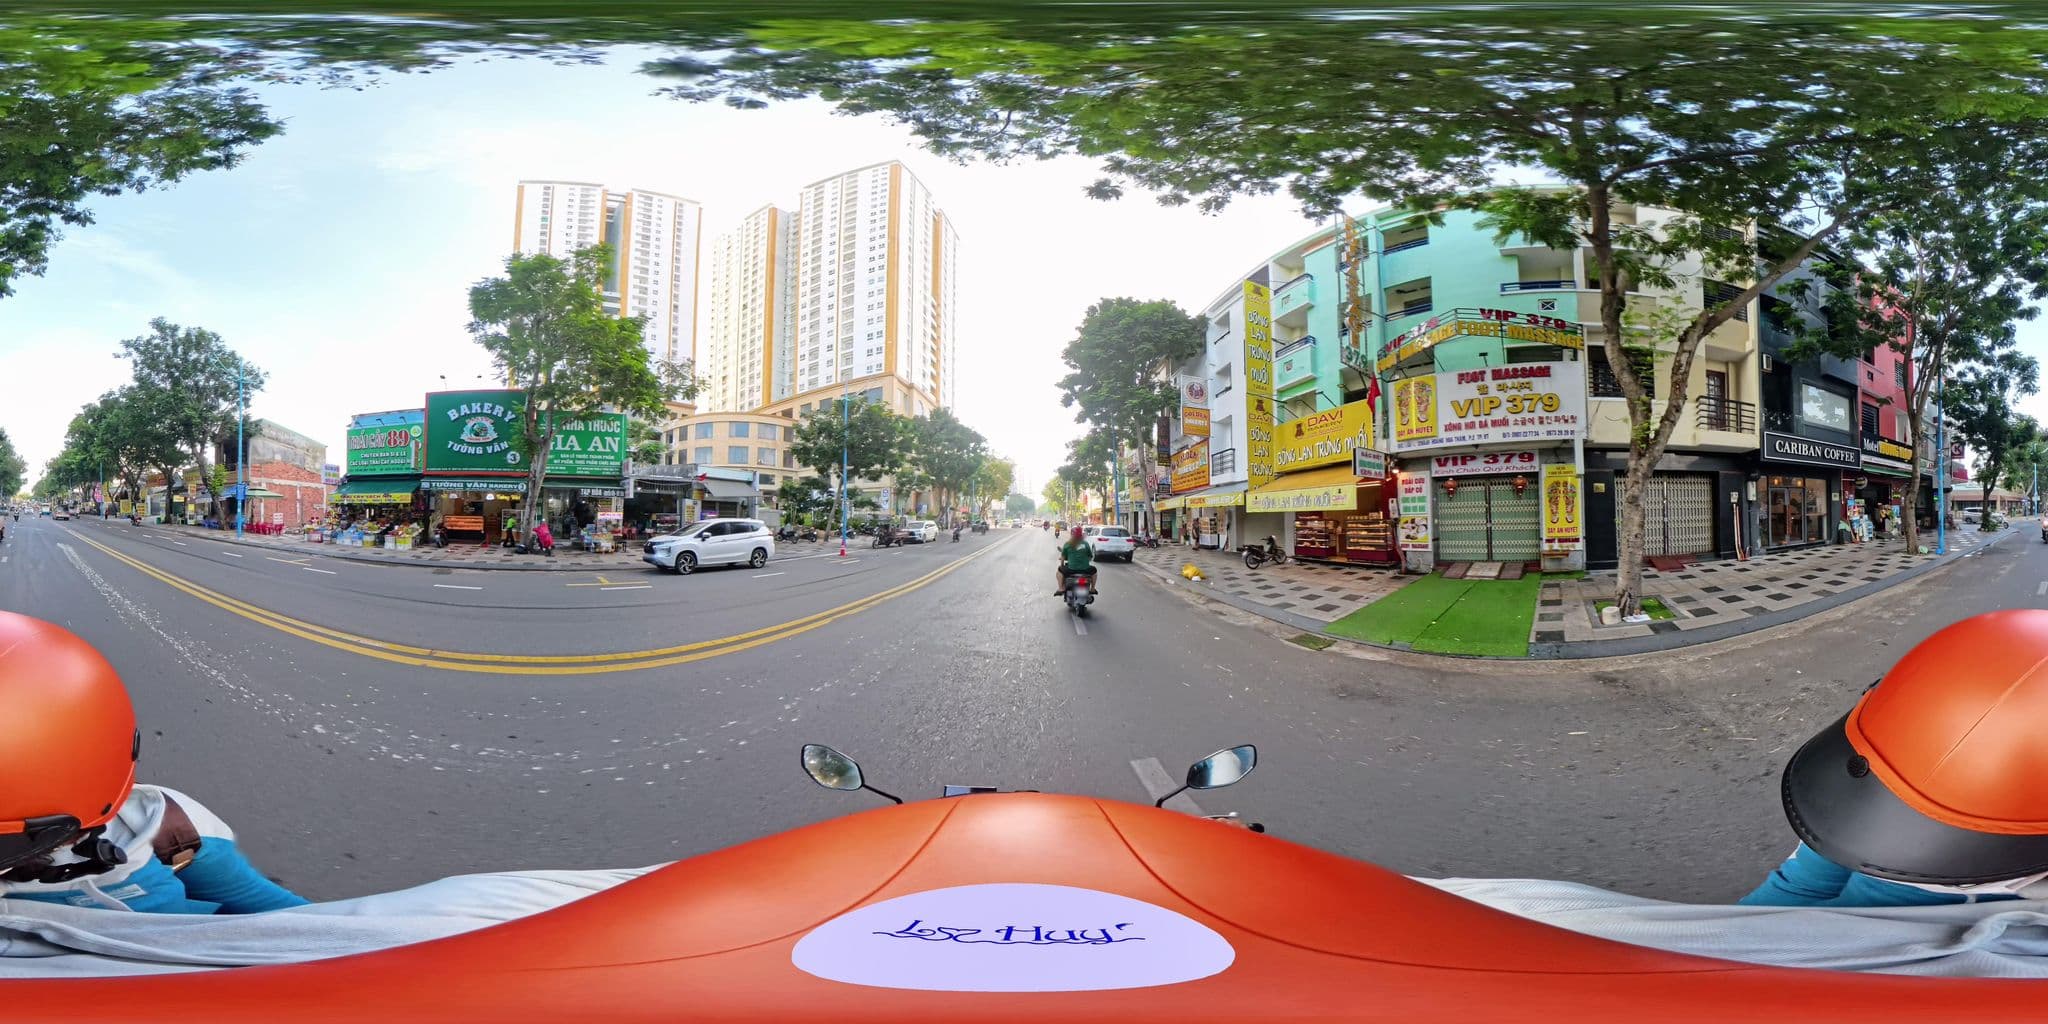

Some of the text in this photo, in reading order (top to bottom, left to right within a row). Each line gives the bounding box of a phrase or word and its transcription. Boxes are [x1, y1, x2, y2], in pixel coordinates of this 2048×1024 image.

[1479, 307, 1518, 322] VIP
[1251, 327, 1268, 343] LAN
[1384, 334, 1406, 354] VIP
[1456, 319, 1585, 351] FOOT MASSAGE
[1457, 365, 1552, 385] FOOT MASSAGE
[447, 402, 517, 422] BAKERY
[1450, 392, 1561, 419] VIP 379
[588, 416, 621, 434] THUỐC
[1307, 409, 1344, 428] DAVI
[387, 428, 411, 448] 89
[587, 435, 620, 453] AN
[1863, 437, 1880, 453] Motel
[447, 440, 483, 455] TƯỜNG
[1254, 445, 1270, 458] LAN
[1298, 445, 1314, 462] LAN
[1775, 439, 1856, 463] CARIBAN COFFEE
[1434, 450, 1536, 468] VIP 379
[1506, 463, 1537, 472] Khách
